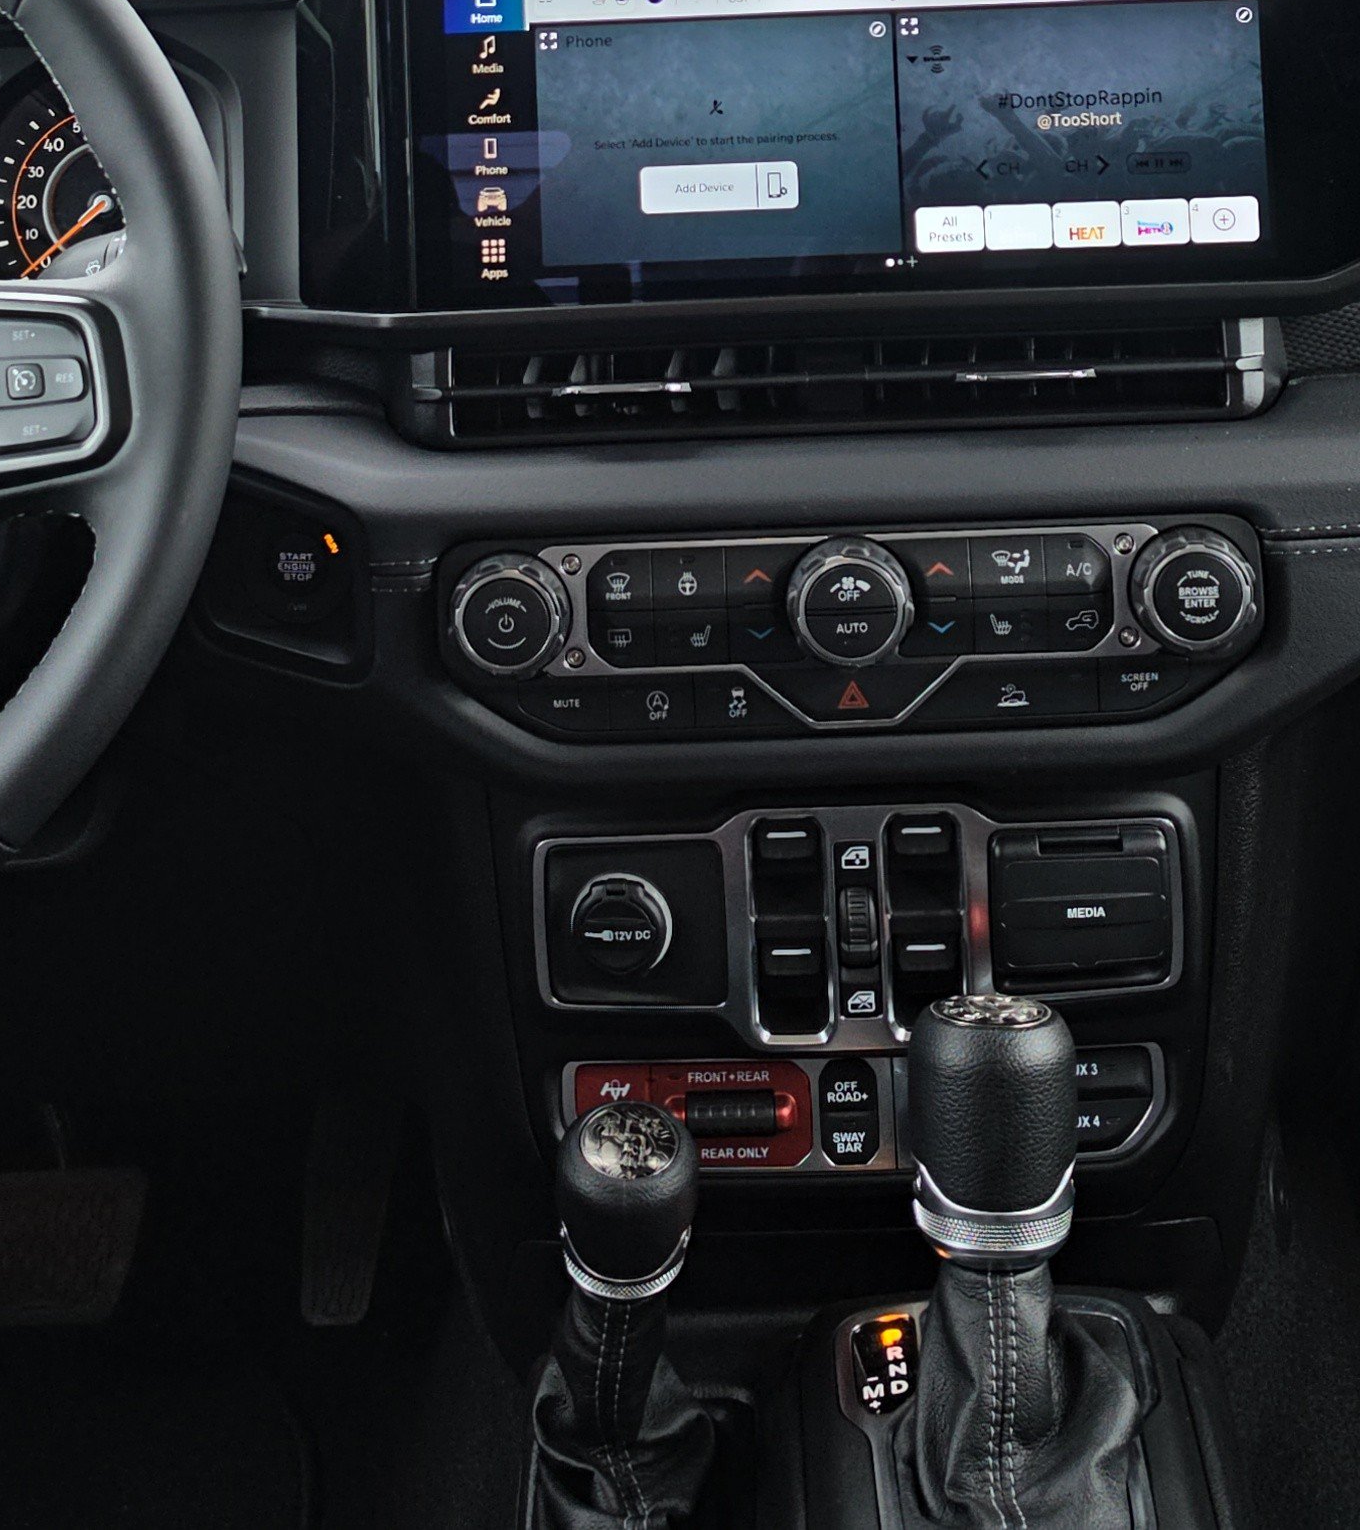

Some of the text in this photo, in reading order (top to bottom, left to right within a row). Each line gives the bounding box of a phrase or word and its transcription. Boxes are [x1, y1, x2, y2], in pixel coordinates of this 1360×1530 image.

[470, 12, 502, 24] Home
[566, 34, 612, 48] Phone
[472, 62, 504, 74] Media
[998, 88, 1162, 109] #DontStopRappin
[468, 112, 511, 125] Comfort
[1037, 112, 1122, 129] @TooShort
[43, 138, 64, 152] 40
[594, 139, 626, 150] Select
[696, 136, 708, 147] to
[710, 134, 735, 146] start
[738, 134, 754, 145] the
[756, 132, 793, 145] pairing
[475, 164, 508, 176] Phone
[997, 163, 1020, 175] CH
[1065, 160, 1088, 172] CH
[28, 166, 44, 179] 30
[675, 181, 734, 194] Add Device
[17, 195, 37, 209] 20
[474, 215, 511, 228] Vehicle
[942, 216, 958, 227] All
[25, 229, 38, 240] 10
[929, 231, 974, 243] Presets
[1069, 226, 1105, 240] HEAT
[481, 267, 508, 281] Apps
[12, 331, 36, 341] SET+
[55, 373, 74, 383] RES
[279, 552, 313, 561] START
[278, 563, 316, 572] ENGINE
[1066, 563, 1092, 577] A/C
[284, 573, 313, 581] STOP
[1001, 575, 1024, 584] MODE
[1188, 570, 1209, 579] TUNE
[606, 592, 631, 601] FRONT
[838, 590, 860, 602] OFF
[1178, 586, 1219, 597] BROWSE
[491, 597, 522, 609] VOLUME
[1185, 598, 1216, 608] ENTER
[1185, 613, 1216, 624] SCROLL
[836, 622, 868, 634] AUTO
[1121, 672, 1159, 683] SCREEN
[1130, 682, 1149, 692] OFF
[553, 699, 580, 708] MUTE
[649, 711, 667, 720] OFF
[729, 709, 747, 718] OFF
[1067, 906, 1106, 920] MEDIA
[614, 929, 651, 941] 12V DC
[834, 1081, 858, 1093] OFF
[827, 1090, 869, 1103] ROAD+
[832, 1132, 866, 1145] SWAY
[701, 1147, 769, 1160] REAR ONLY
[837, 1141, 863, 1154] BAR
[881, 1329, 902, 1346] P
[887, 1346, 904, 1361] R
[888, 1362, 907, 1377] N
[863, 1383, 884, 1400] M
[890, 1380, 909, 1394] D
